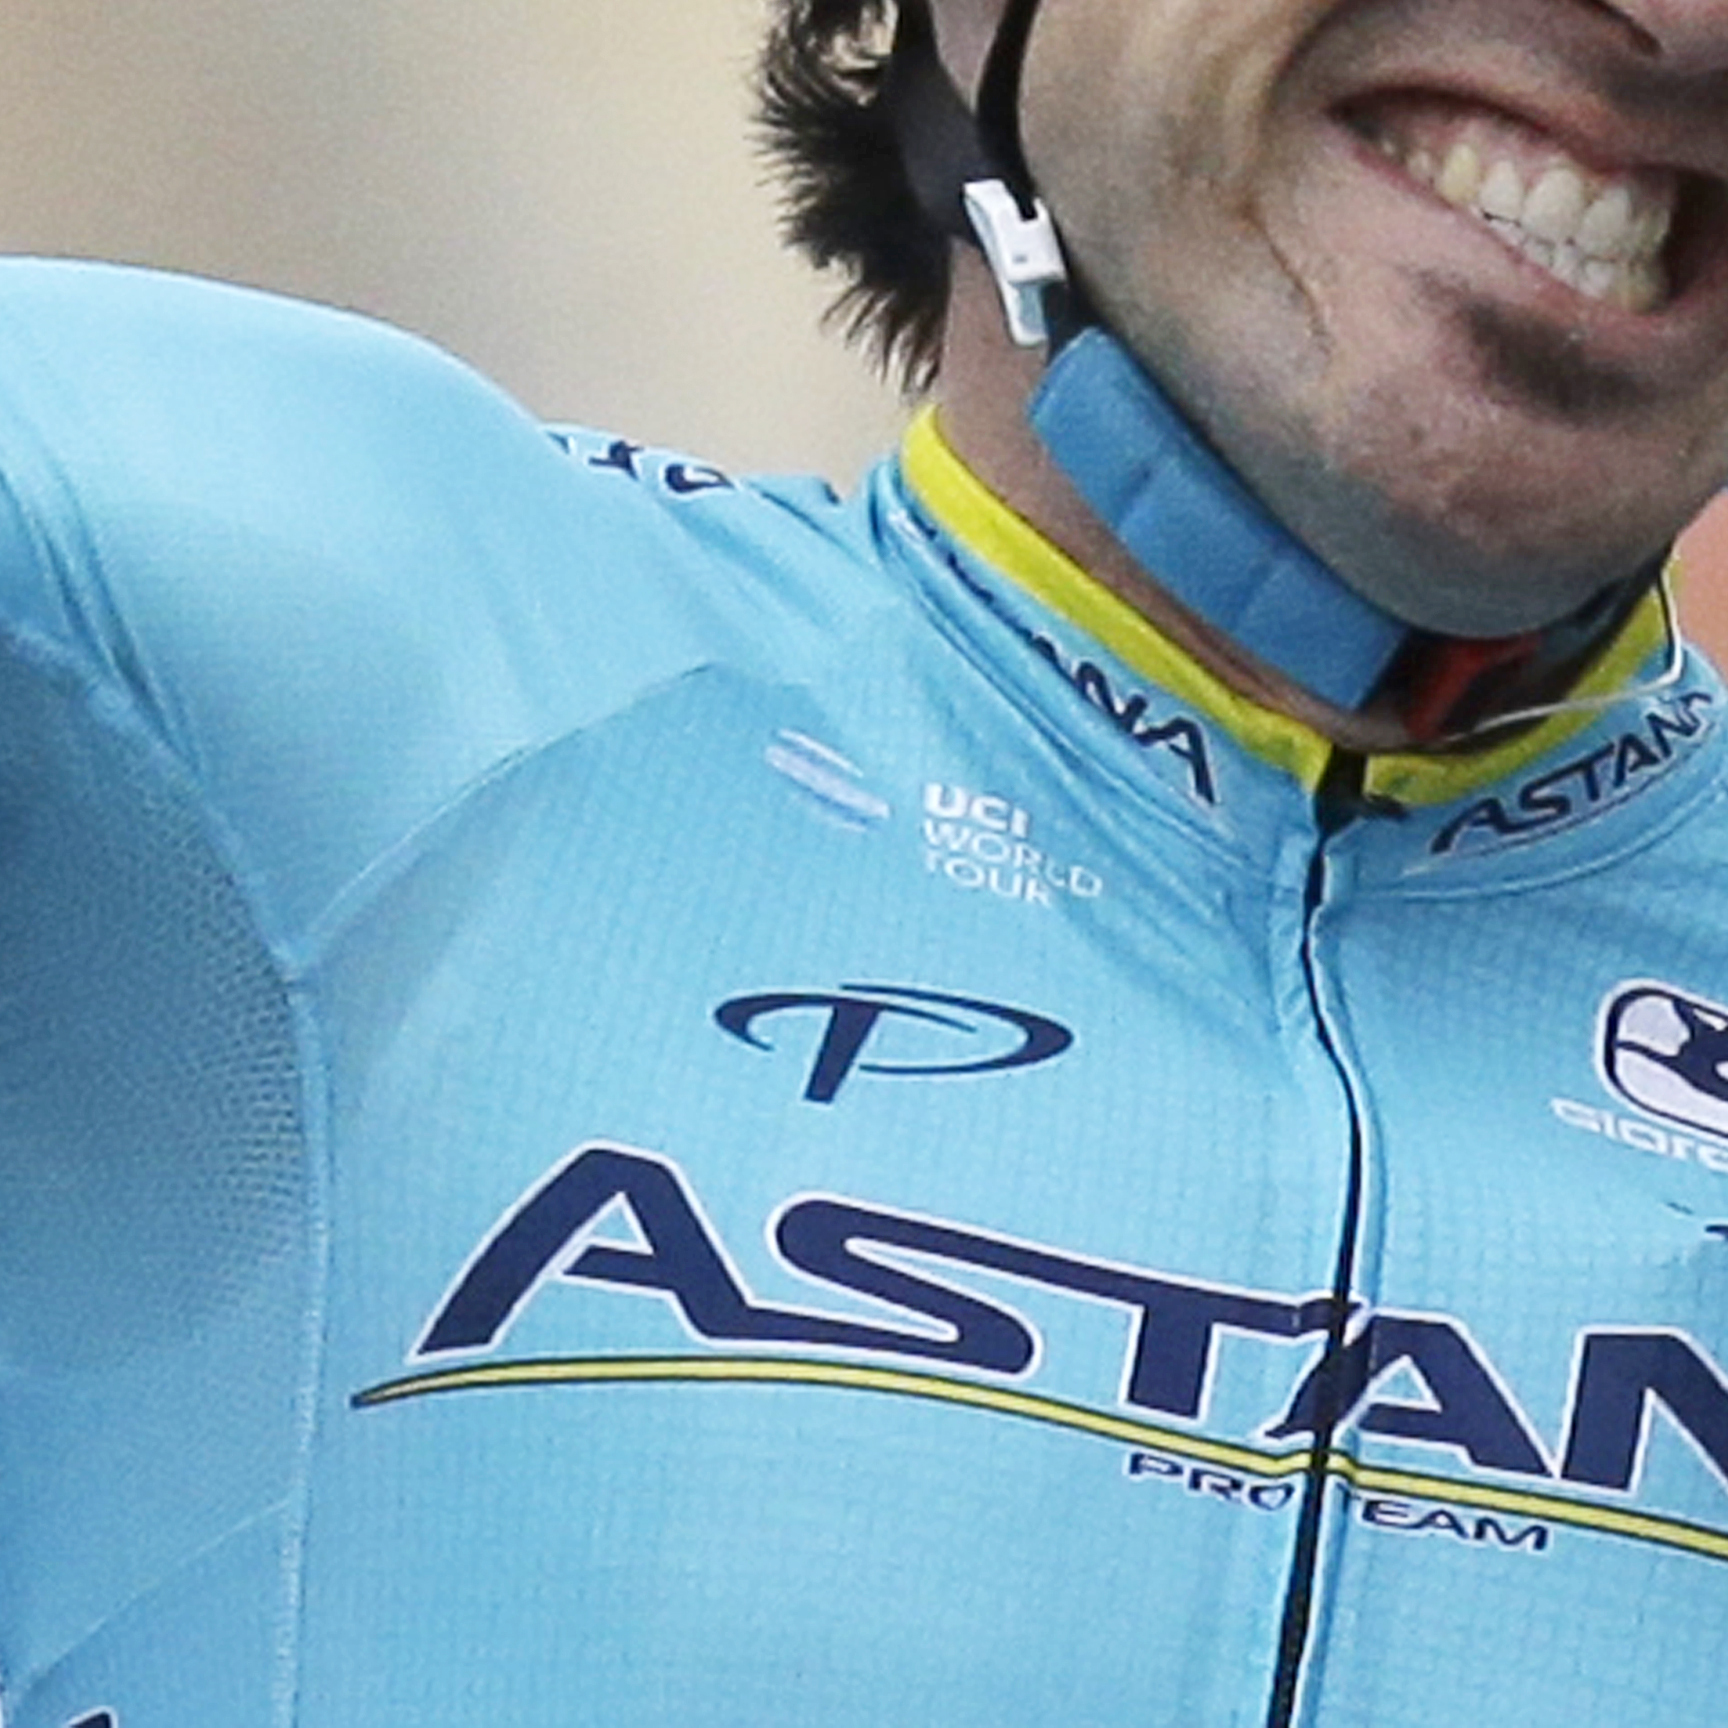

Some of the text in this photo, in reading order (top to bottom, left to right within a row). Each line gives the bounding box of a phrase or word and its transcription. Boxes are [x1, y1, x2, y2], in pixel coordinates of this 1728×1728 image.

[924, 782, 1029, 839] UCI
[924, 818, 1104, 898] WORLD
[927, 850, 1052, 908] TOUR
[1128, 1452, 1296, 1510] PRO
